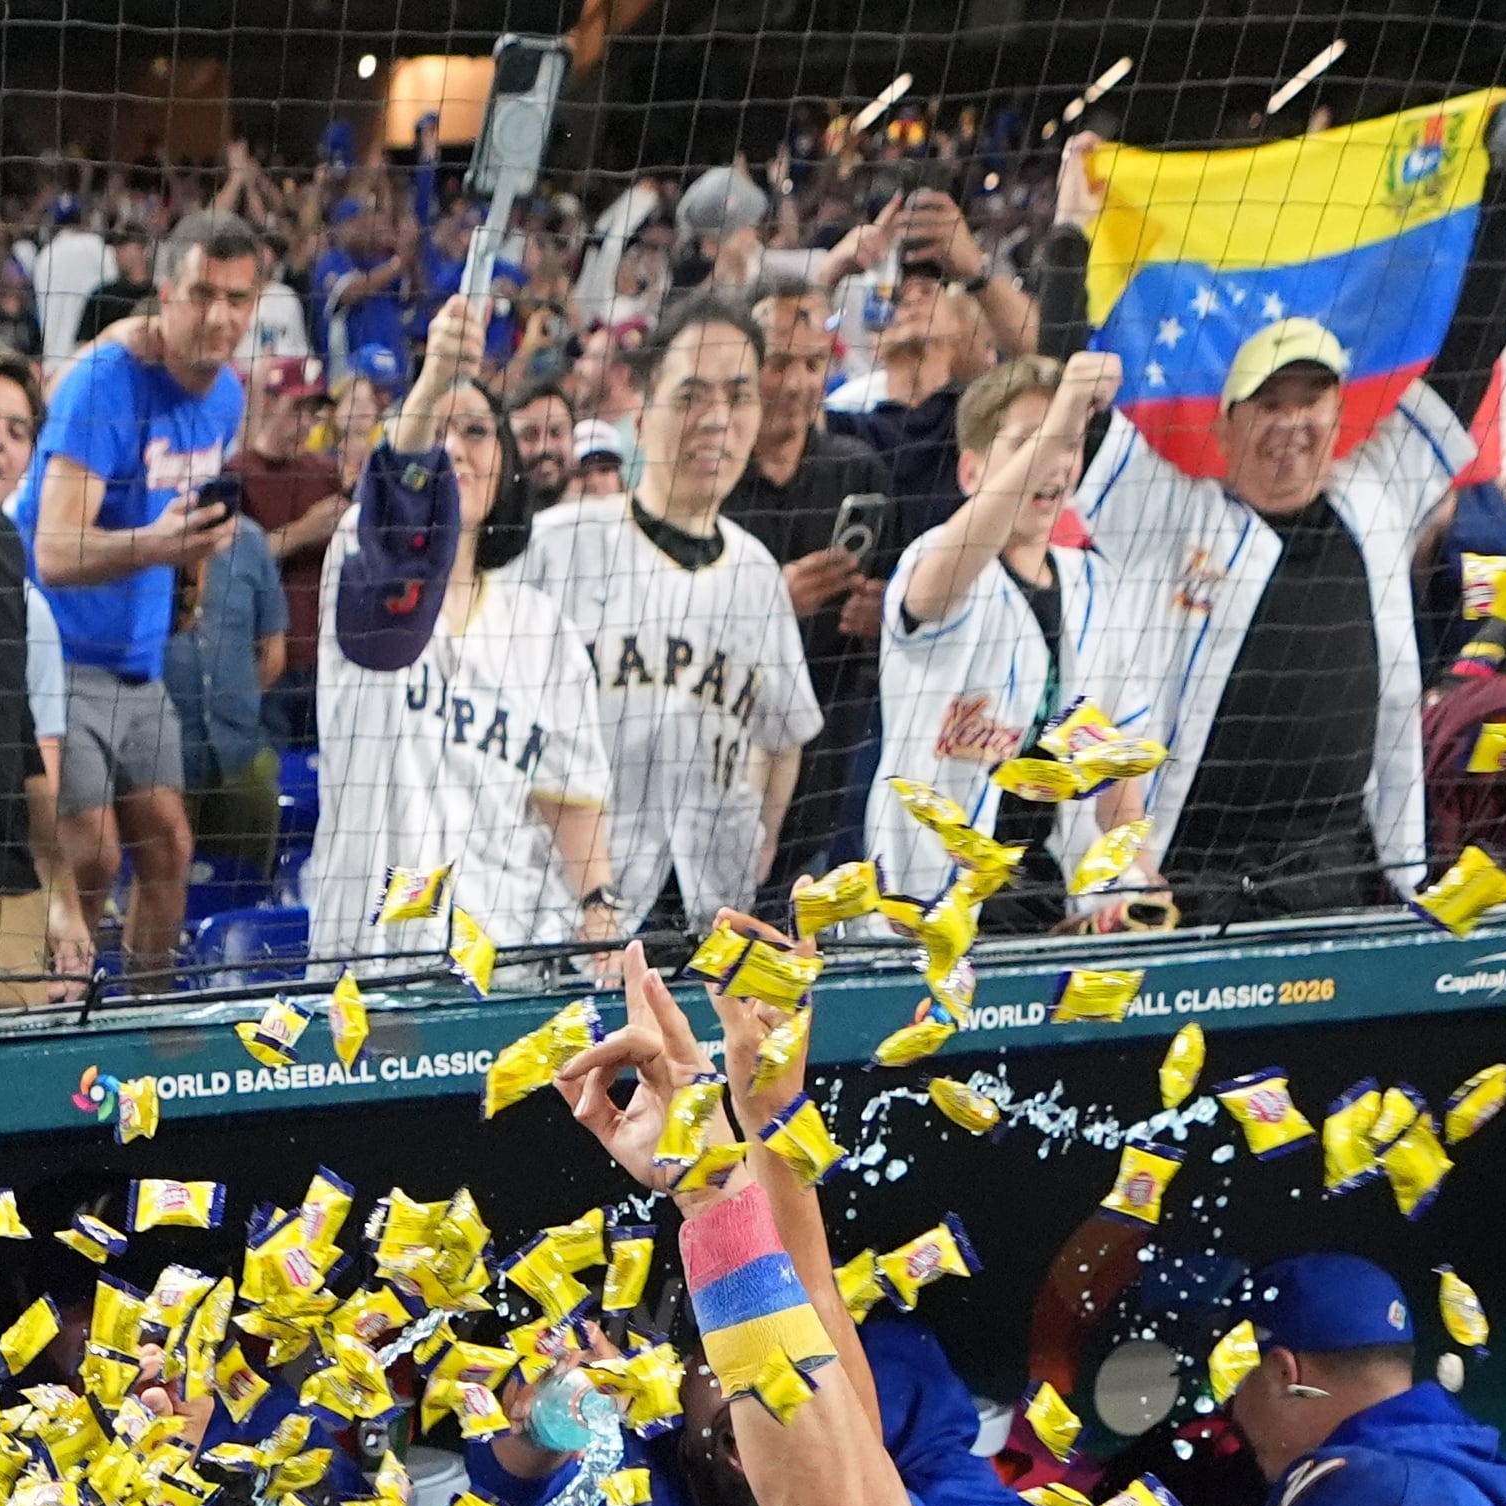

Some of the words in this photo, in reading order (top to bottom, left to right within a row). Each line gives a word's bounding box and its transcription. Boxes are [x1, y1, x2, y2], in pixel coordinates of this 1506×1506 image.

[586, 634, 762, 727] APAN
[1174, 984, 1275, 1013] CLASSIC
[1278, 979, 1336, 1004] 2026
[235, 1060, 377, 1094] BASEBALL
[380, 1050, 494, 1082] CLASSIC
